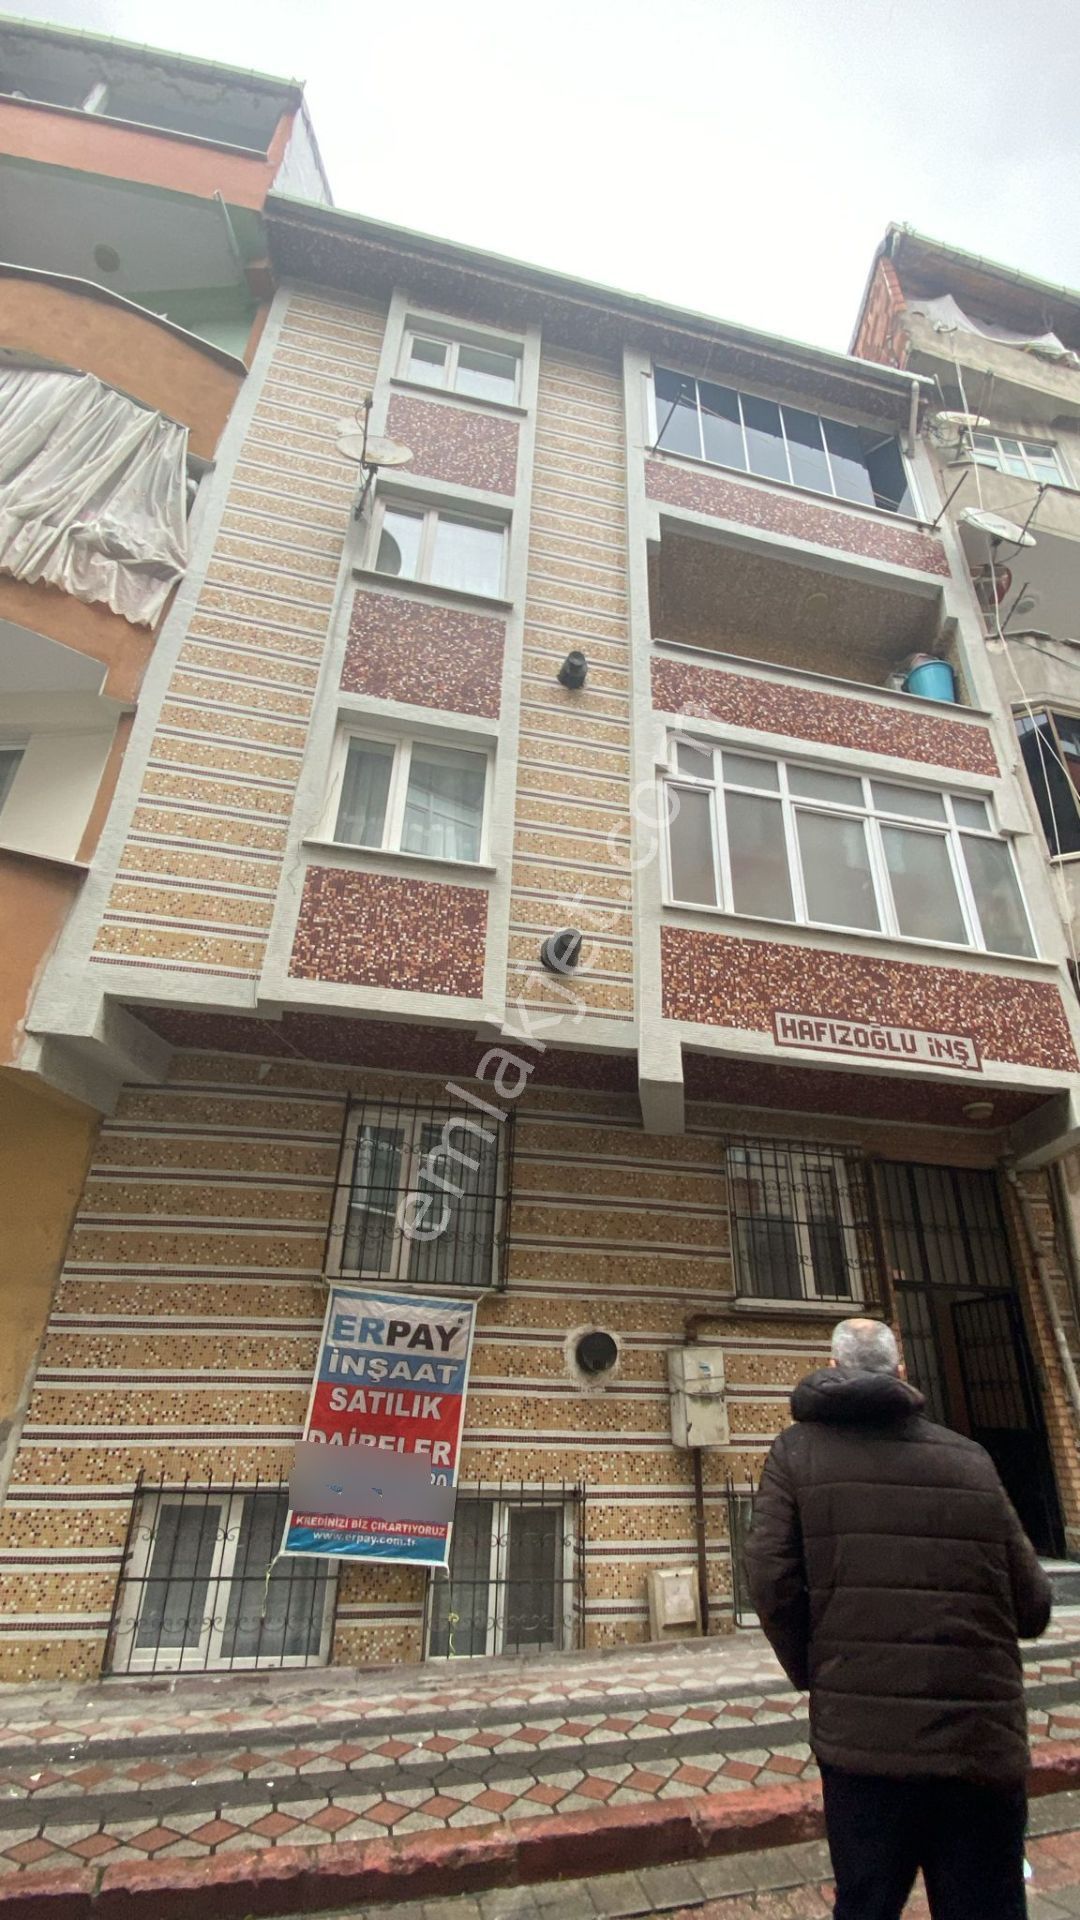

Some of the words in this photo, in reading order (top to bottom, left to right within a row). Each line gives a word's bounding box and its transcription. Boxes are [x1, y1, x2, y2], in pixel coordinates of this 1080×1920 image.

[332, 1314, 460, 1351] ERPAY
[328, 1348, 459, 1384] İNŞAAT
[329, 1387, 443, 1420] SATILIK
